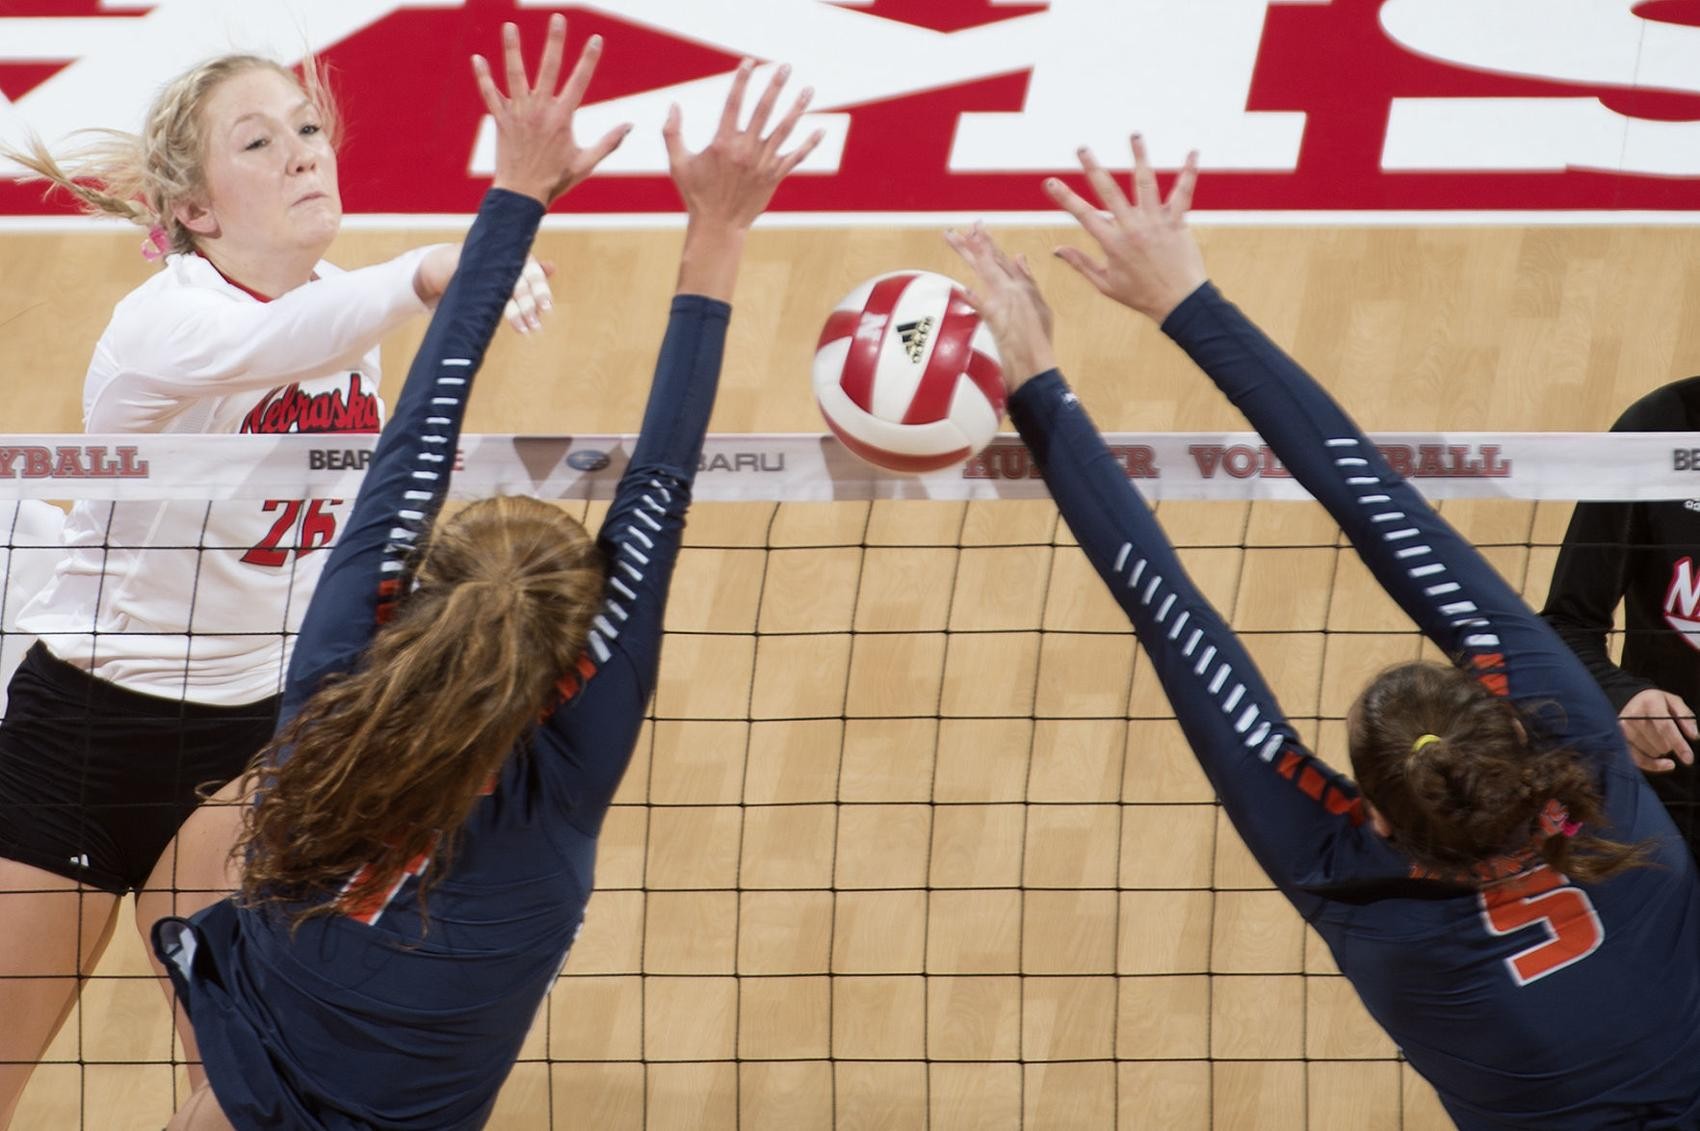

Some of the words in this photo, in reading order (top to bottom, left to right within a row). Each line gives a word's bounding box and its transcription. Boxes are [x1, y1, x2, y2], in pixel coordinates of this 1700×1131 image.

[239, 373, 381, 434] Nebraska
[0, 446, 149, 479] YBALL
[239, 499, 344, 567] 26
[1478, 863, 1605, 987] 5
